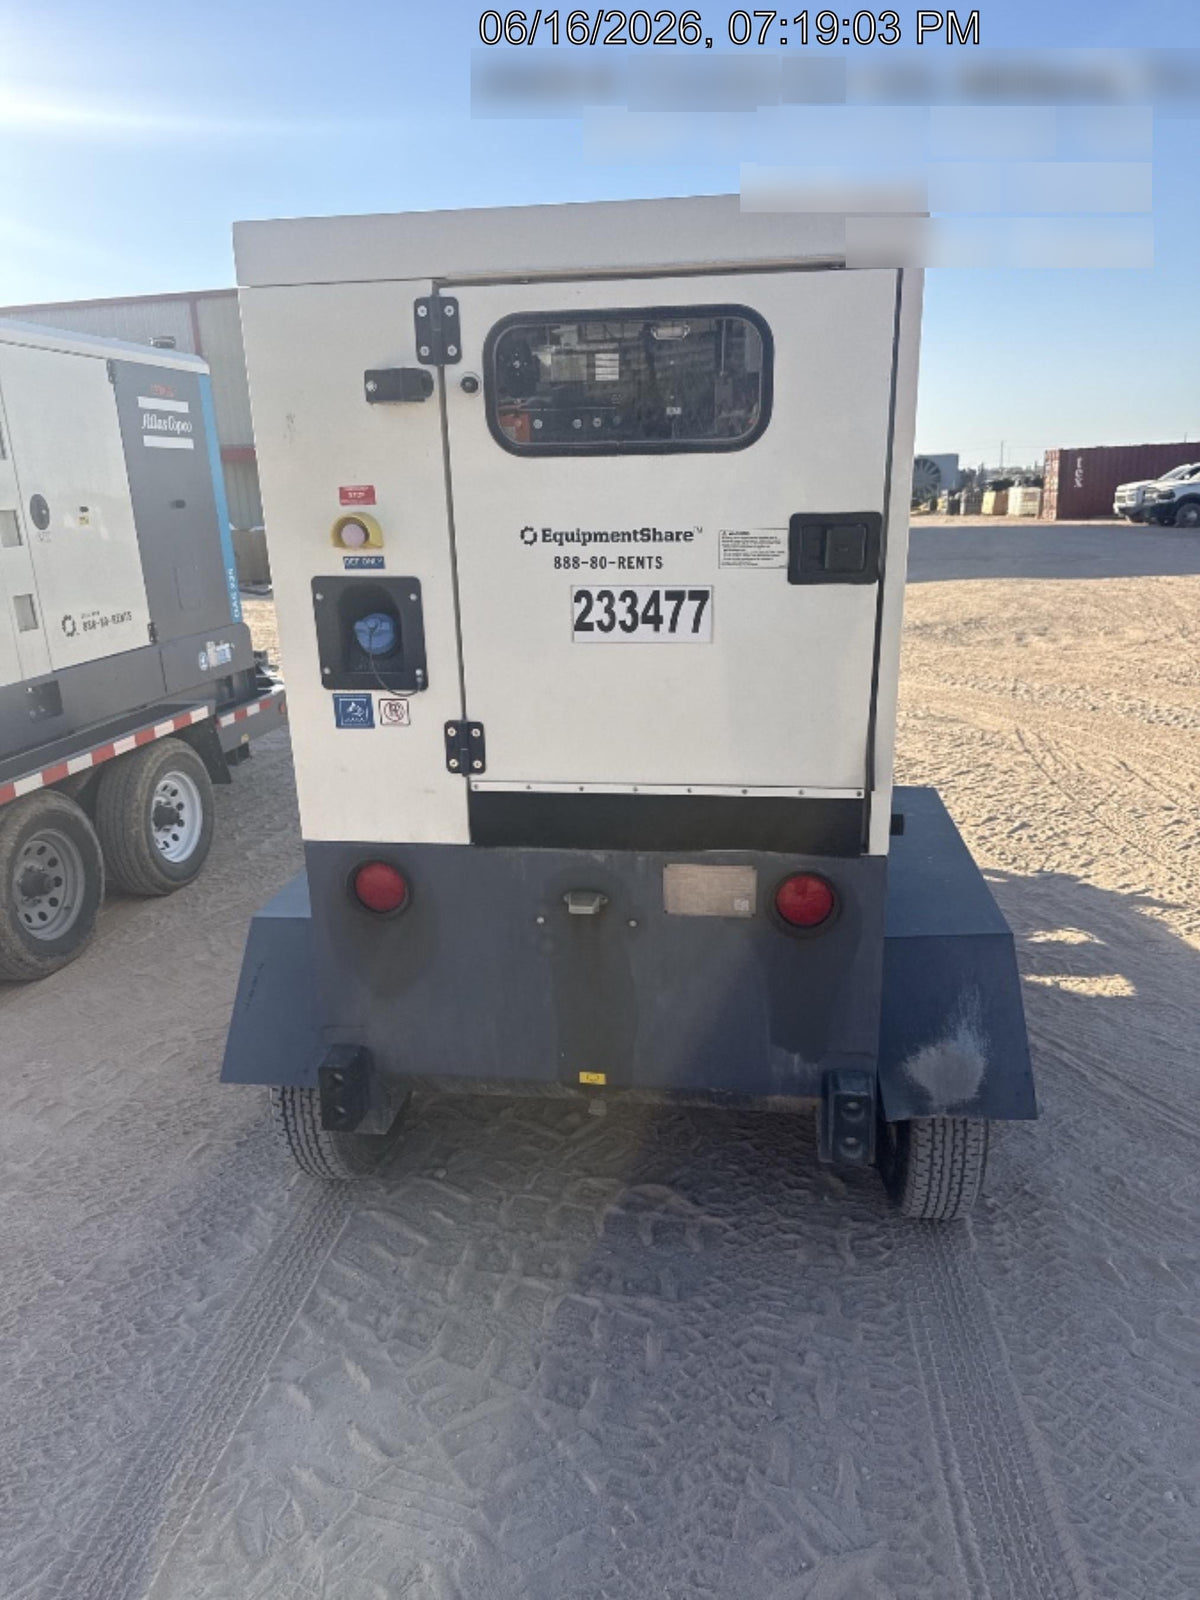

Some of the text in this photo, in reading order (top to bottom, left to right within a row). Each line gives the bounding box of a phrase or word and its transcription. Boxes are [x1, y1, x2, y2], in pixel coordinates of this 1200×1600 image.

[541, 527, 695, 546] EquipmentShare
[553, 555, 664, 570] 888-80-RENTS
[573, 589, 710, 634] 233477
